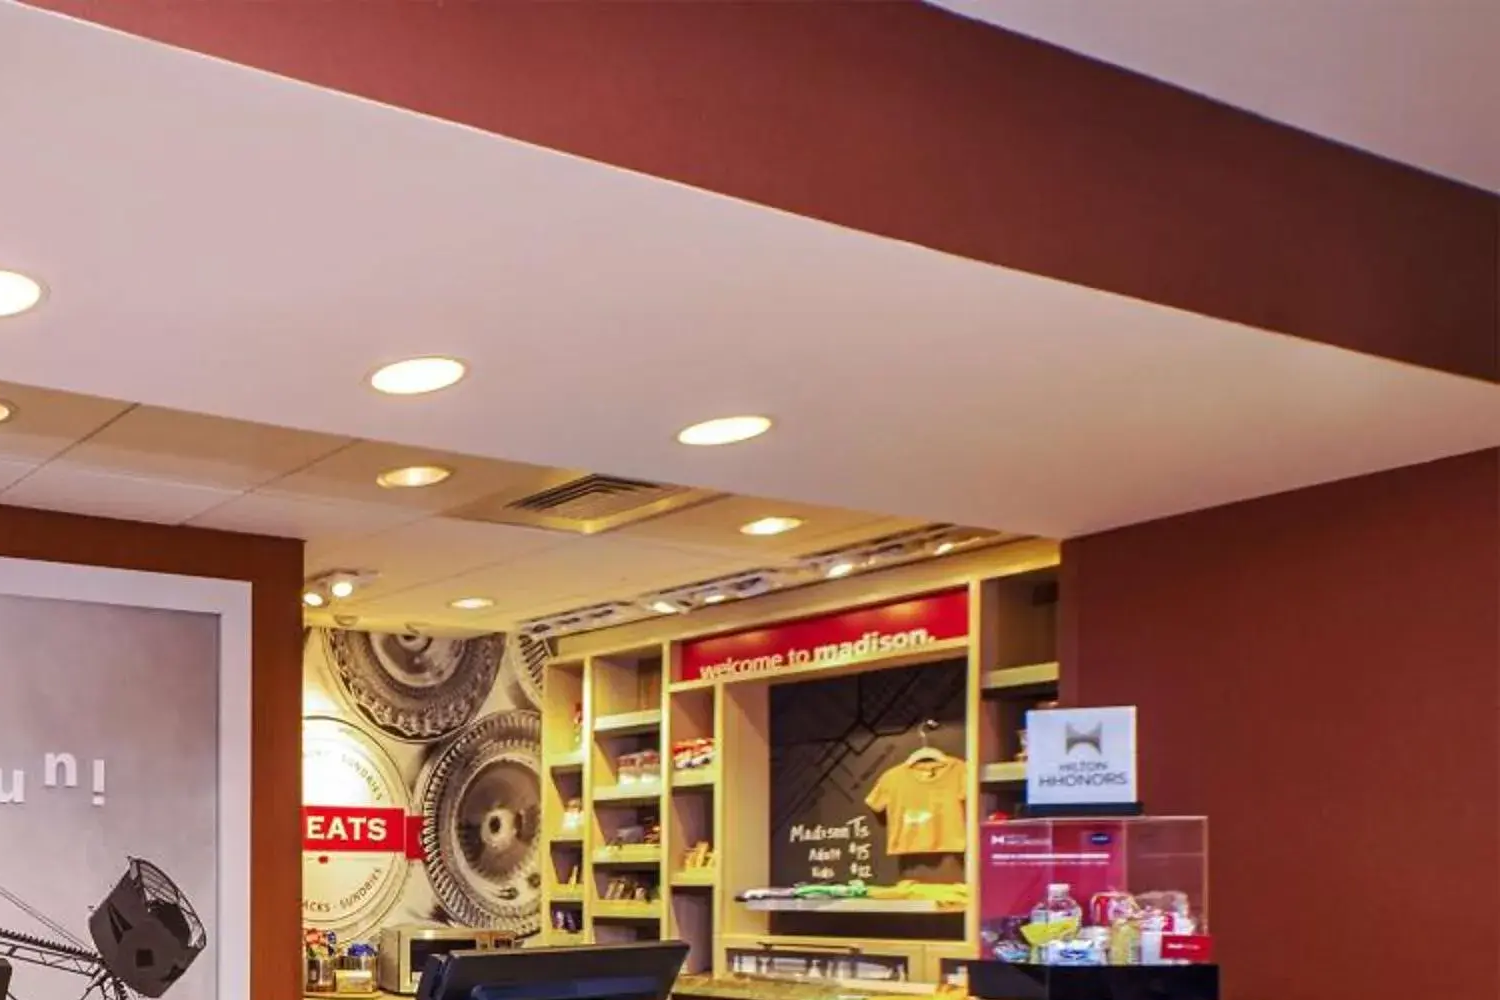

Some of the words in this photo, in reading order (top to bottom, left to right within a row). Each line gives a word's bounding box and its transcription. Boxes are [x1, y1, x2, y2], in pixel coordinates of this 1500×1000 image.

[699, 651, 783, 680] welcome
[788, 647, 809, 666] to
[813, 627, 936, 663] madison.
[1038, 772, 1128, 788] HHONORS
[306, 815, 388, 842] EATS
[789, 823, 850, 843] Madison
